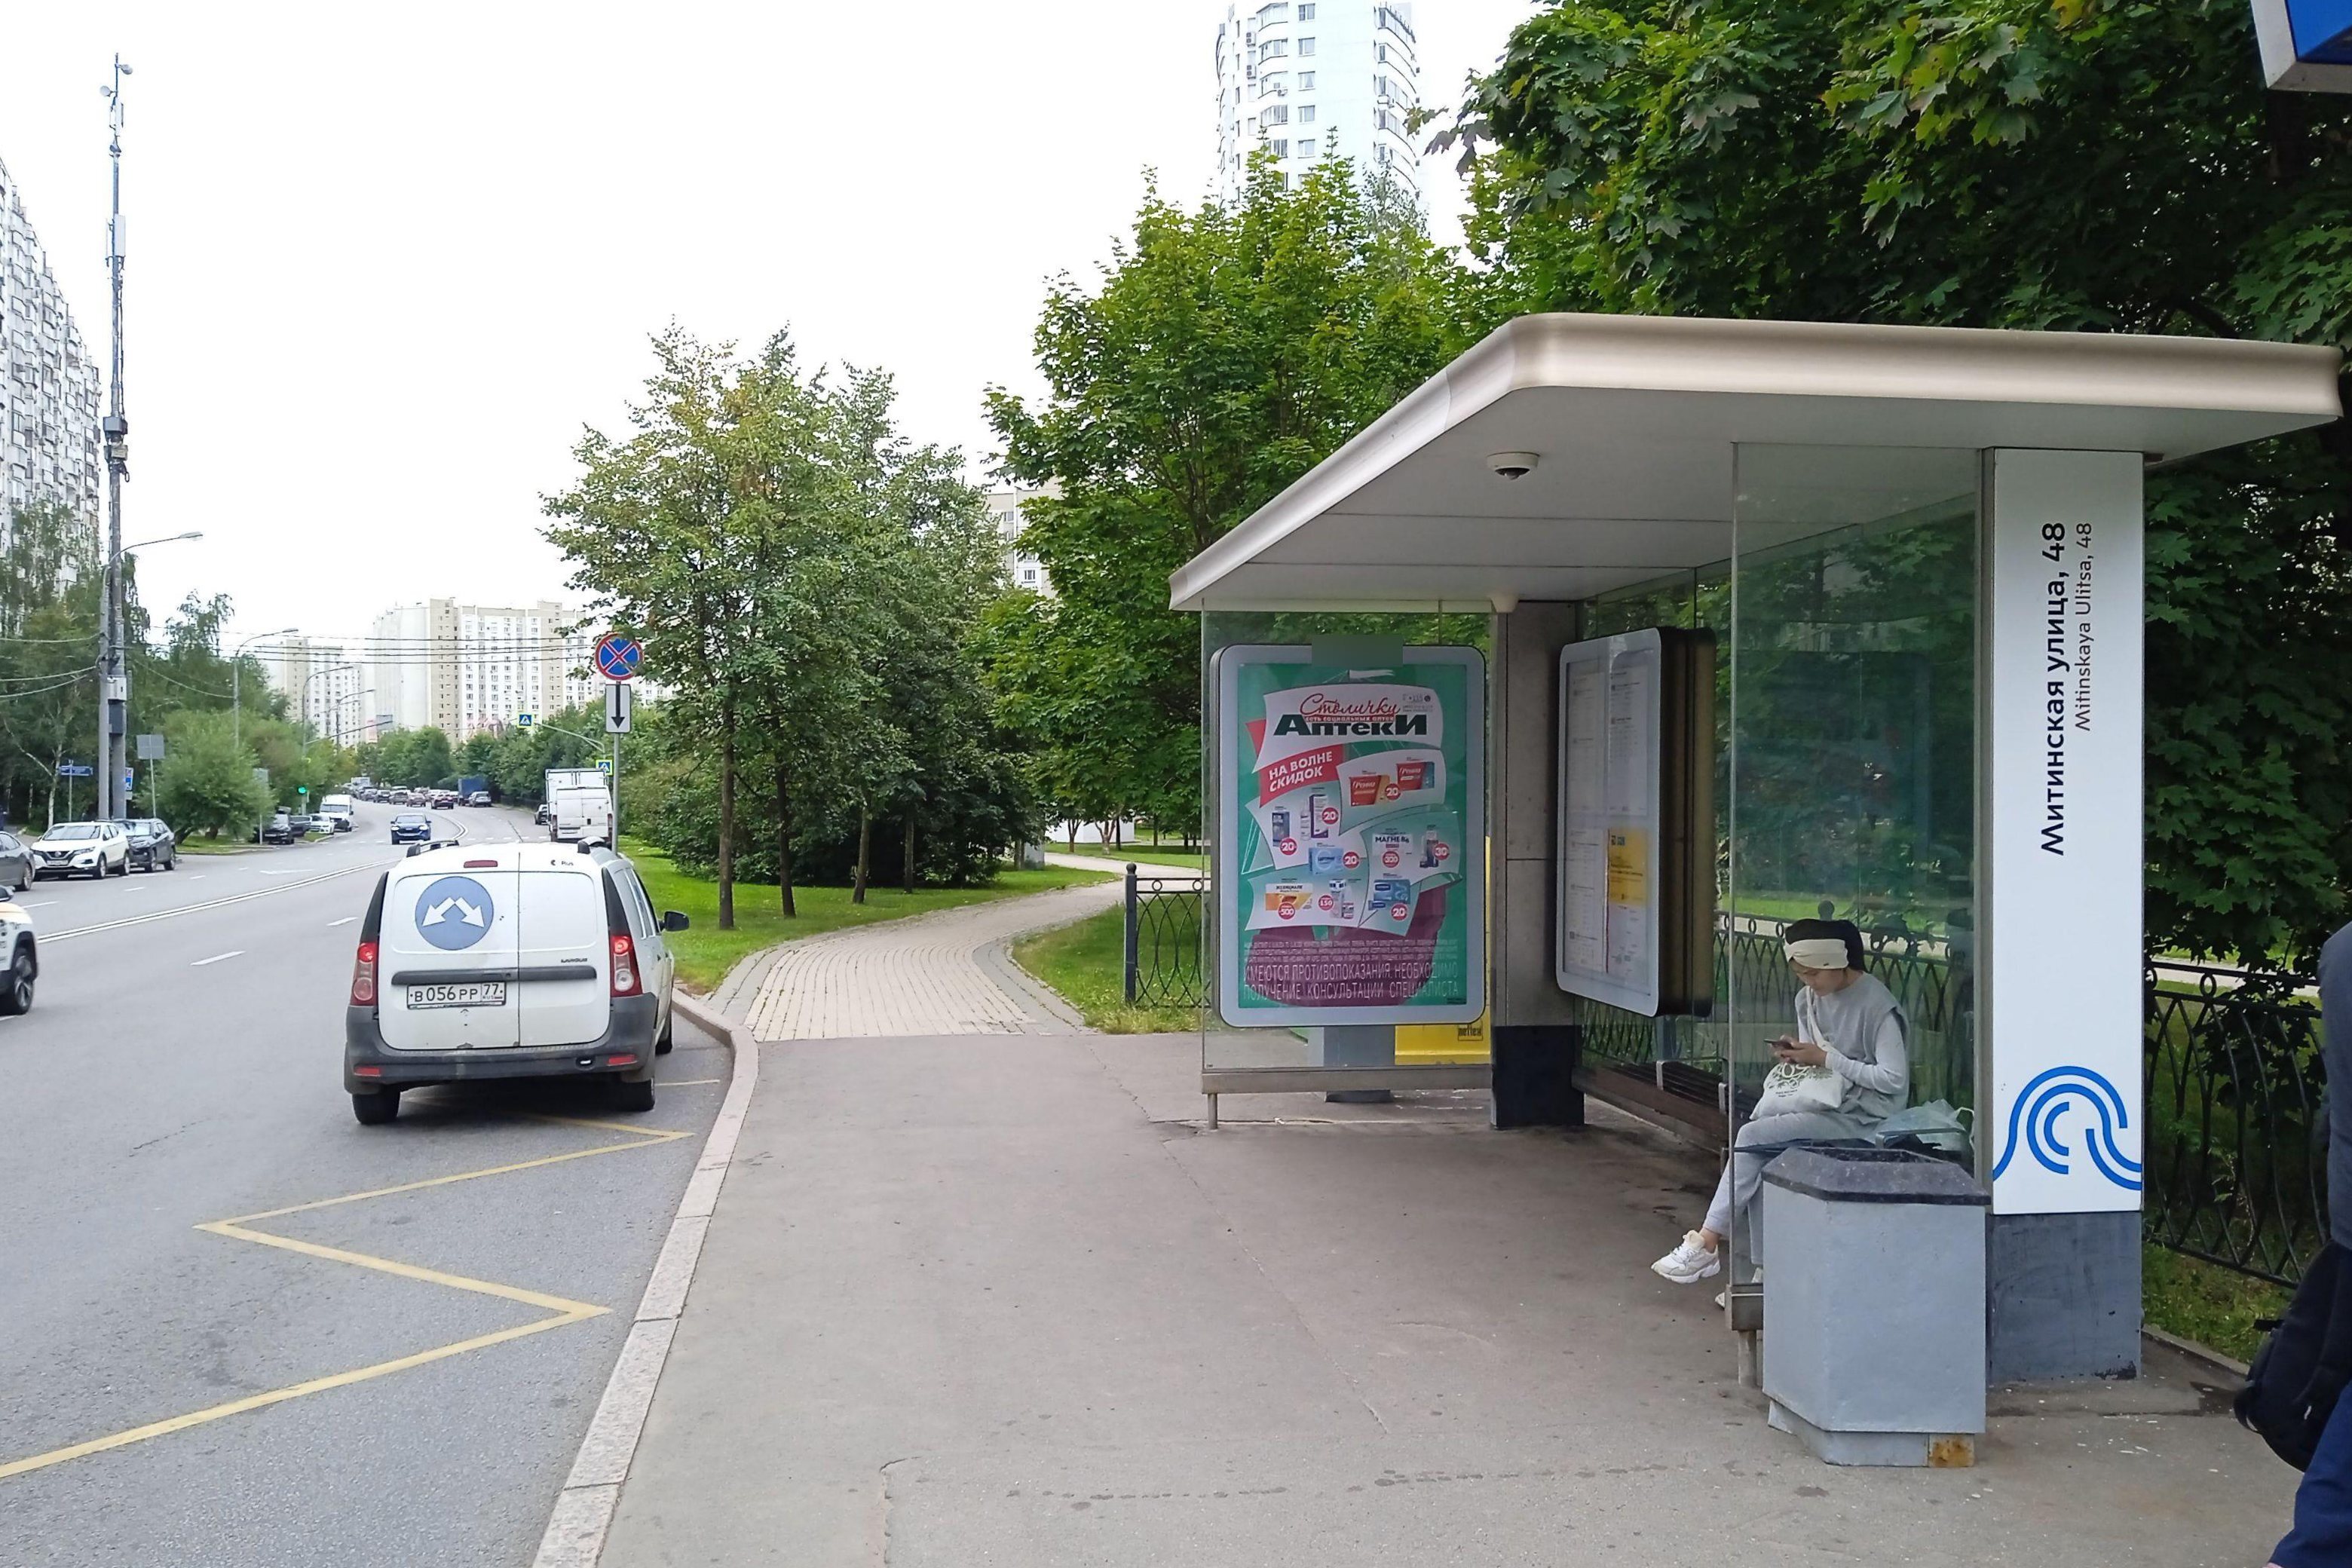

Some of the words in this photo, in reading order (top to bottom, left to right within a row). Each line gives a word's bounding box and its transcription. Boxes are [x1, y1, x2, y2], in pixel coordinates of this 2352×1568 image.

[2041, 522, 2066, 562] 48
[2076, 522, 2092, 549] 48
[2075, 555, 2094, 615] Ulitsa,
[2047, 571, 2070, 672] улица,
[2075, 622, 2094, 731] Mitinskaya
[1300, 693, 1401, 715] Столички
[1269, 765, 1288, 780] НА
[1290, 751, 1333, 772] ВОЛНЕ
[1269, 765, 1323, 792] СКИДОК
[2041, 681, 2064, 856] Митинская
[1244, 965, 1289, 982] ИМЕЮТСЯ
[1395, 962, 1458, 979] НЕОБХОДИМО
[1244, 983, 1301, 1001] ПОЛУЧЕНИЕ
[1307, 982, 1383, 1000] КОНСУЛЬТАЦИИ
[1389, 980, 1459, 998] СПЕЦИАЛИСТА
